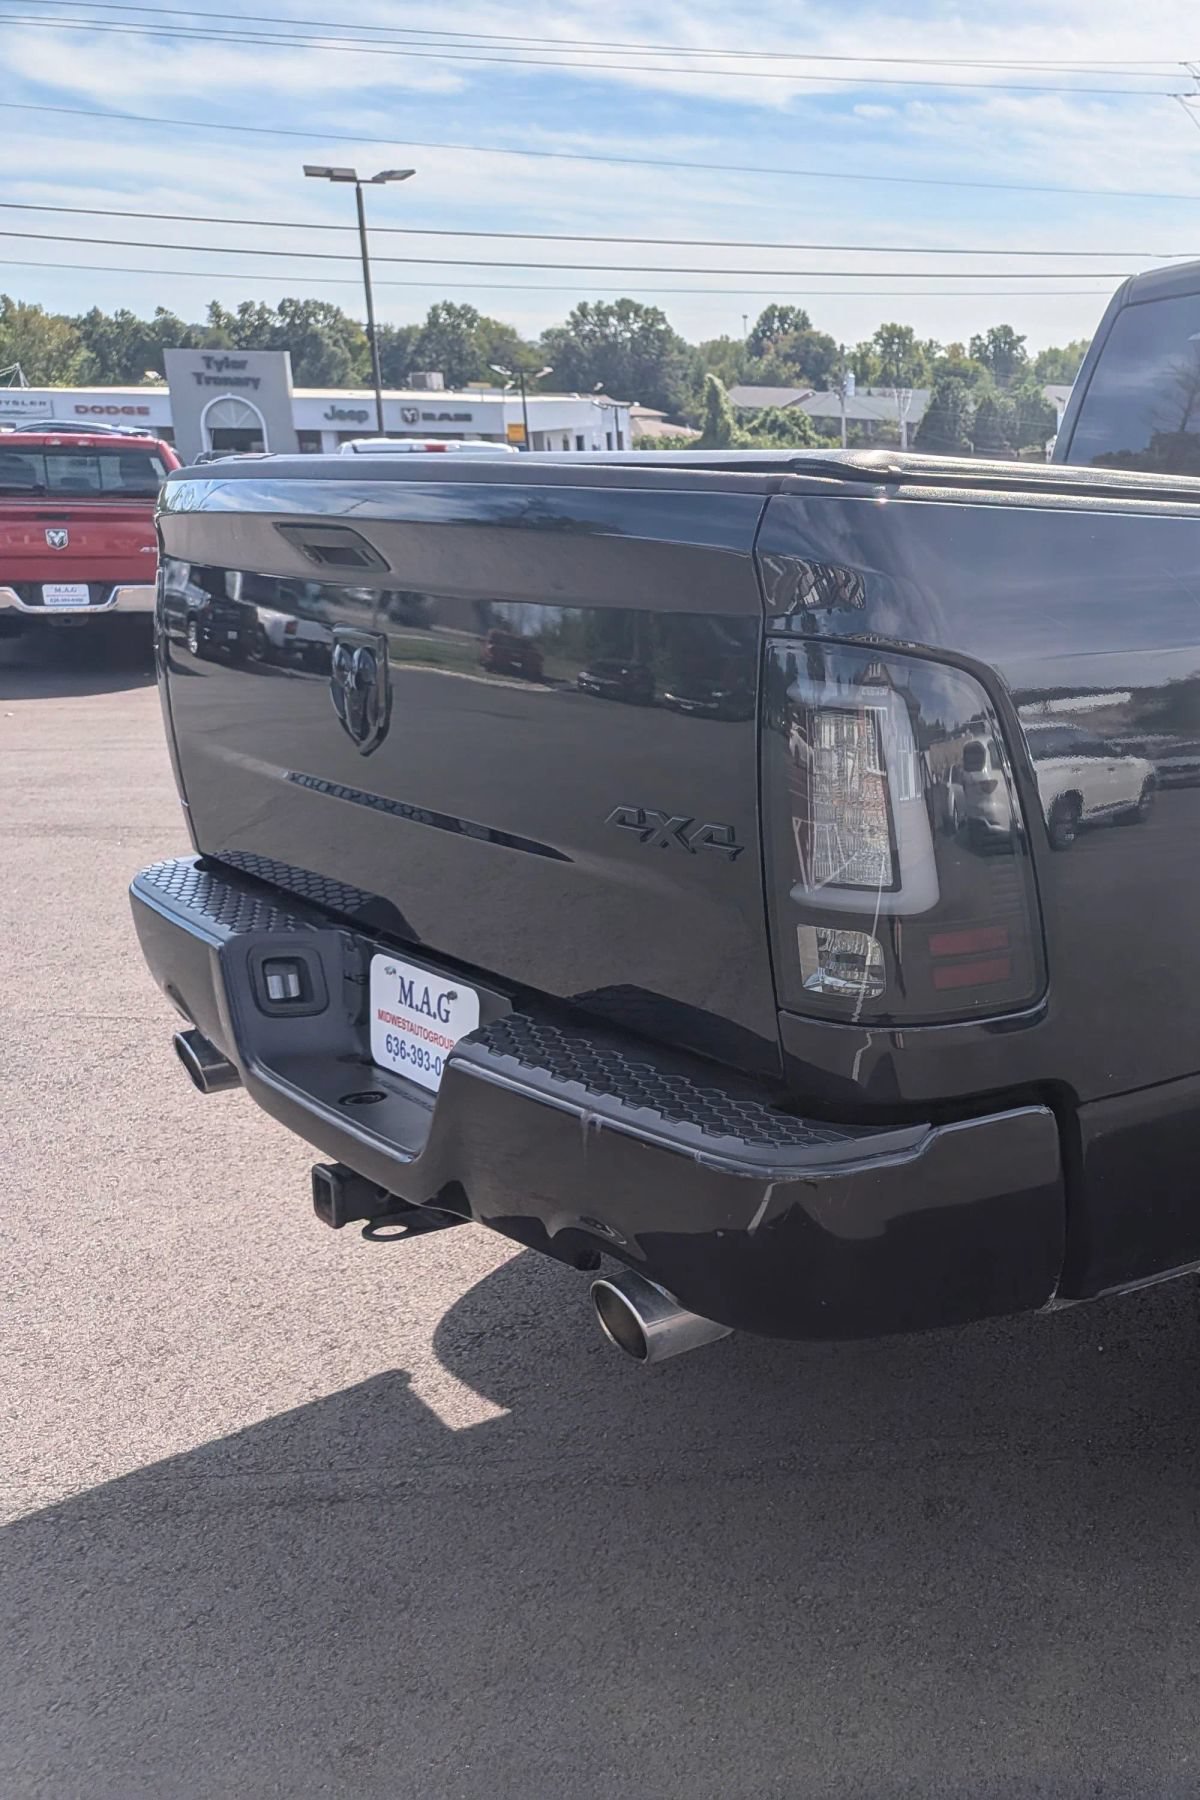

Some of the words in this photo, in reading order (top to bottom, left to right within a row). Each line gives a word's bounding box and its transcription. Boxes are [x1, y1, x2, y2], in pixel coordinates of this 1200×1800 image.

[202, 356, 248, 373] Tyler
[74, 404, 151, 416] DODGE
[323, 405, 369, 424] Jeep
[421, 412, 473, 422] RAM
[397, 975, 452, 1024] M.A.G
[386, 1033, 446, 1077] 636-393-0
